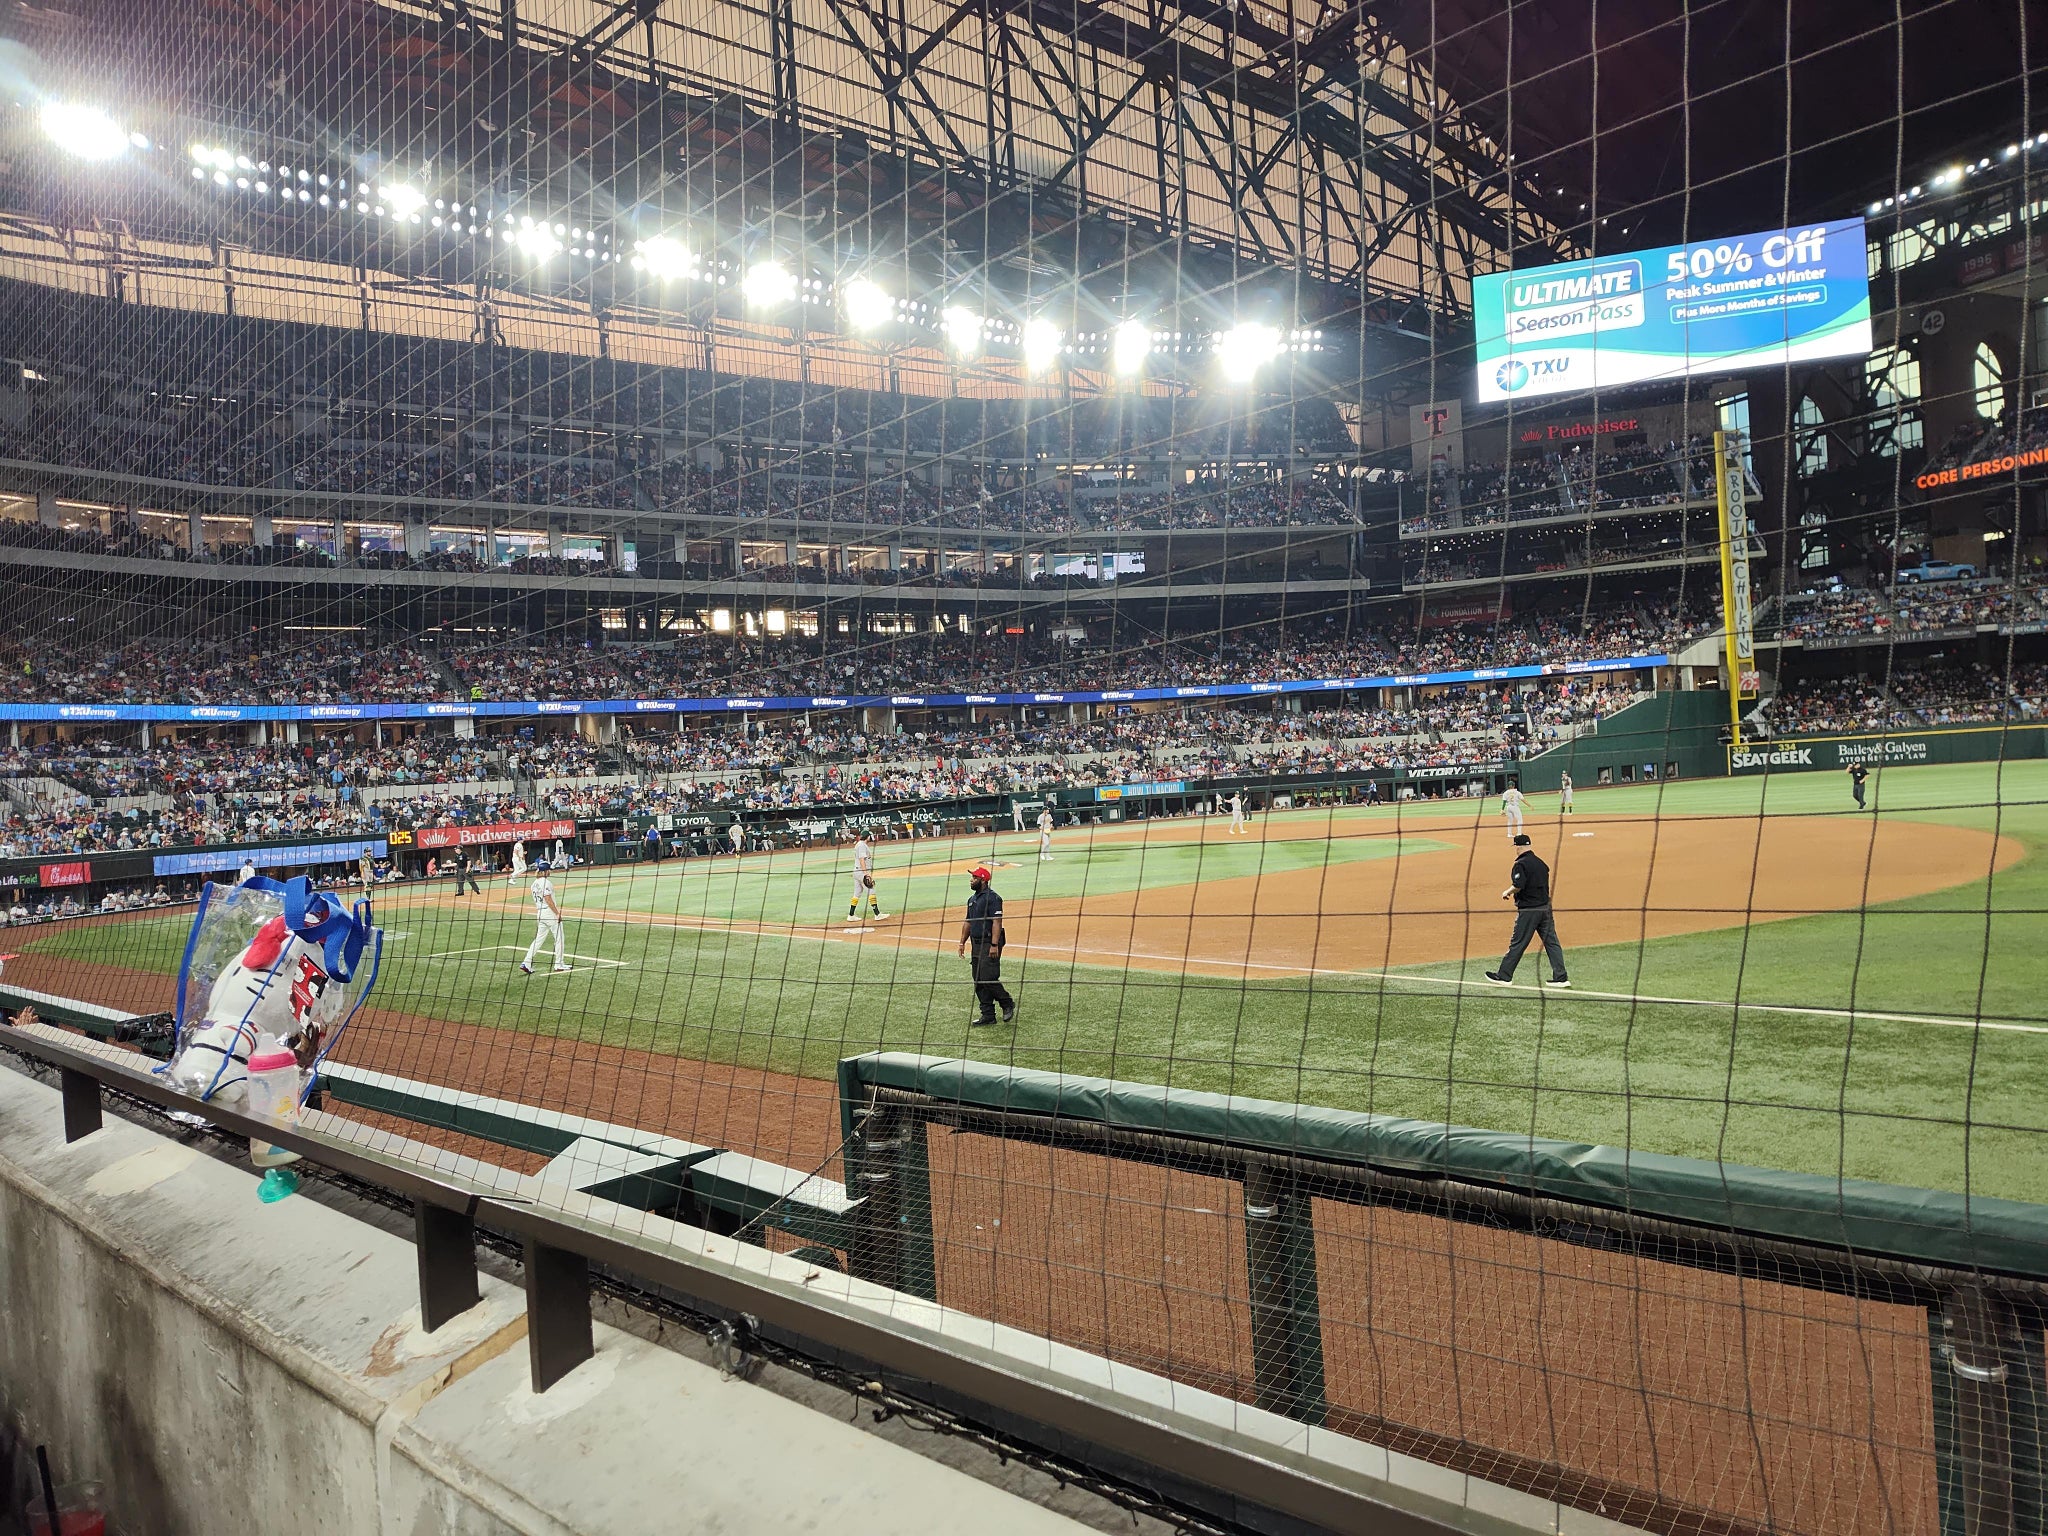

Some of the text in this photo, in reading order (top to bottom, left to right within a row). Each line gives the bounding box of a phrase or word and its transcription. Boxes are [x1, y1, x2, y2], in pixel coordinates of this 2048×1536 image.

[1667, 227, 1826, 282] 50% Off
[1514, 269, 1632, 307] ULTIMATE
[1667, 268, 1827, 300] Peak Summer & Winter
[1699, 303, 1726, 315] More
[1727, 297, 1766, 312] Months
[1767, 294, 1779, 306] of
[1780, 290, 1821, 305] Savings
[1516, 303, 1633, 333] Season Pass
[1924, 314, 1941, 330] 42
[1532, 357, 1570, 376] TXU
[1916, 469, 1958, 489] CORE
[1838, 744, 1873, 757] Bailey
[1885, 741, 1926, 755] Galyen
[1732, 749, 1812, 769] SEATGEEK
[1840, 756, 1890, 764] ATTORNES
[1408, 767, 1462, 778] VICTORY
[675, 817, 710, 827] TOYOTA
[459, 828, 541, 844] Budweiser
[302, 850, 321, 858] Over
[3, 876, 18, 886] Life
